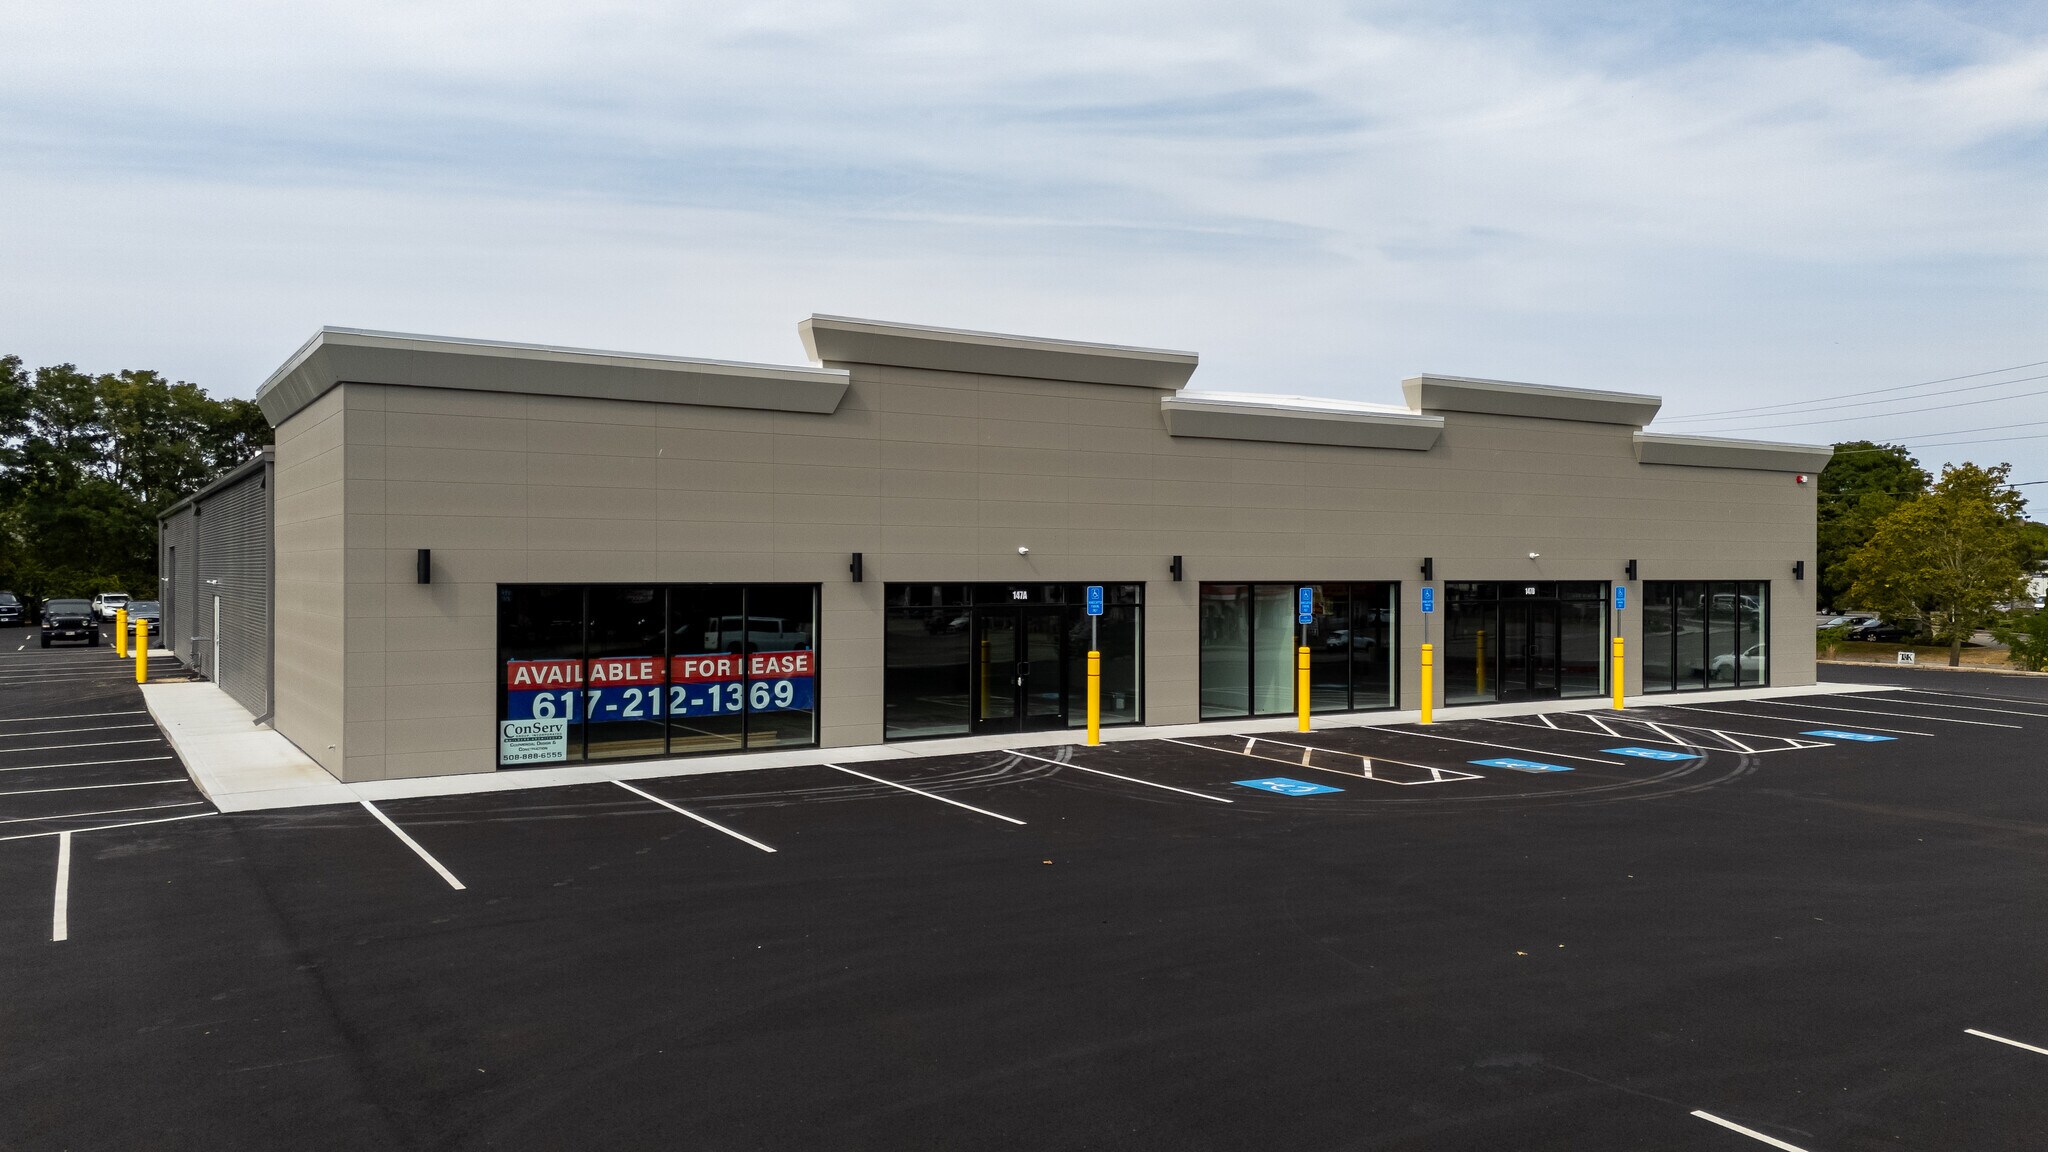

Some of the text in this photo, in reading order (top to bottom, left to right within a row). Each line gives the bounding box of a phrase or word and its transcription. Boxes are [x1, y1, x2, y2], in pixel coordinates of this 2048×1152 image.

[1012, 590, 1028, 600] 147A
[514, 662, 653, 685] AVAILABLE
[685, 659, 731, 678] FOR
[532, 680, 794, 721] 617-212-1369
[504, 722, 563, 738] ConServ
[504, 752, 562, 760] 508-888-6555
